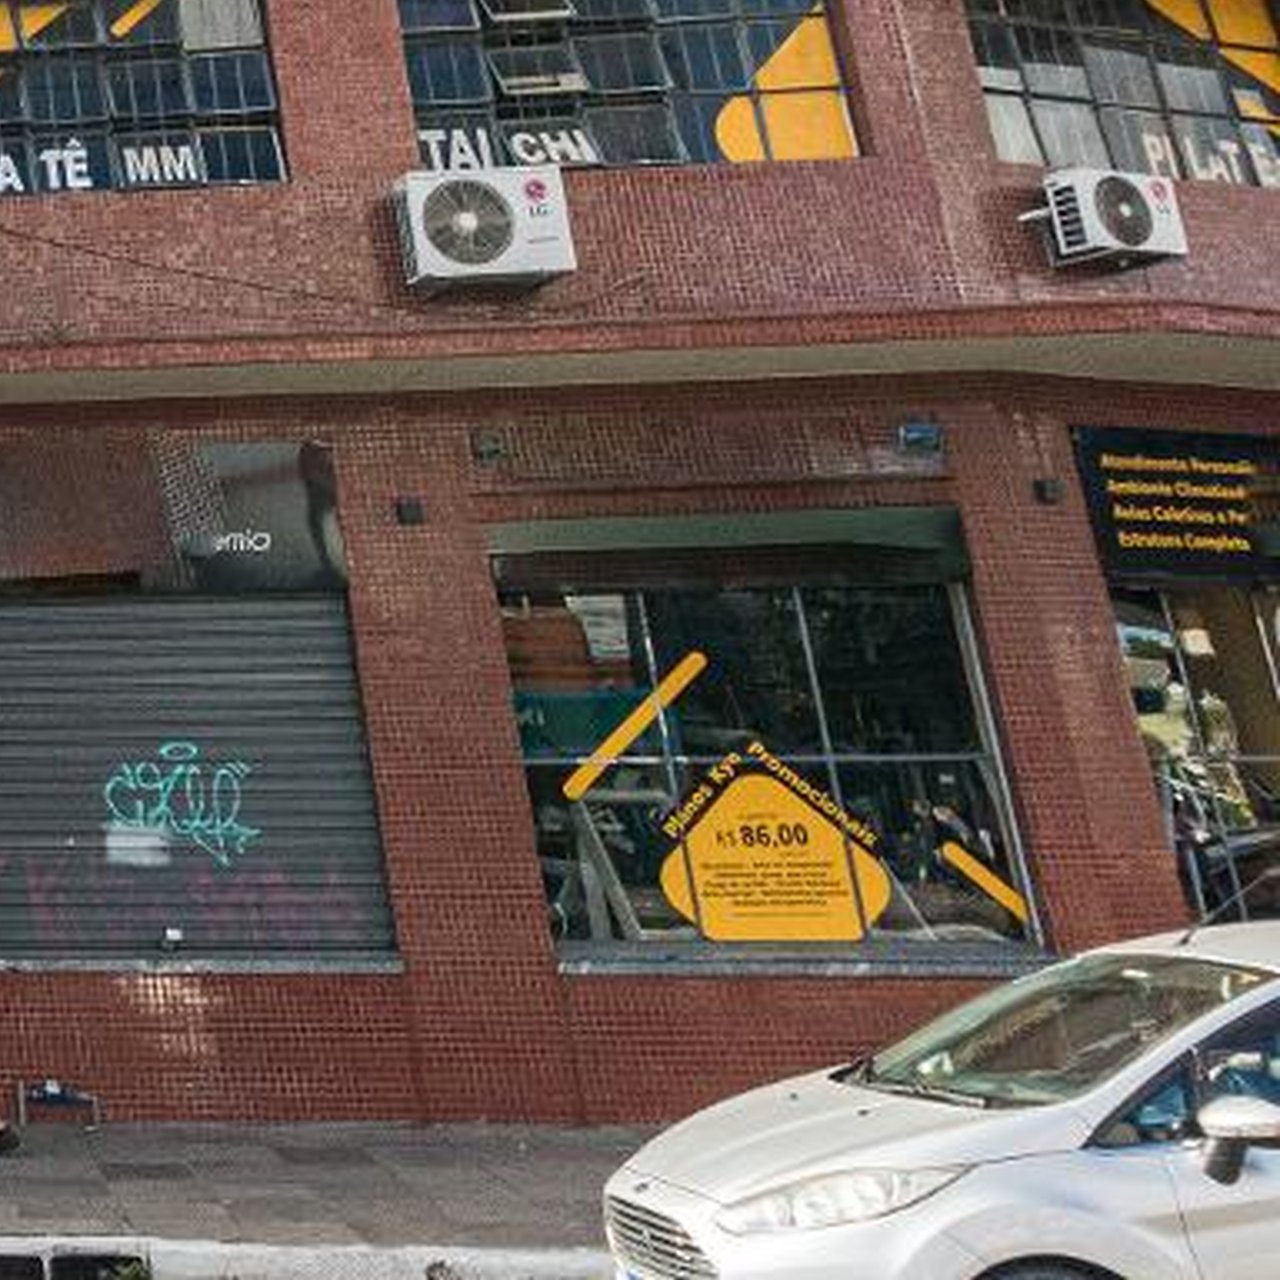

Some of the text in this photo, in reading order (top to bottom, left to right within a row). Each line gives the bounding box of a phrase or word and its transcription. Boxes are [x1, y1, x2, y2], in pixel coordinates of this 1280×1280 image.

[418, 128, 598, 170] TAI CHI
[662, 784, 713, 838] Planos
[747, 741, 878, 847] Promocionais
